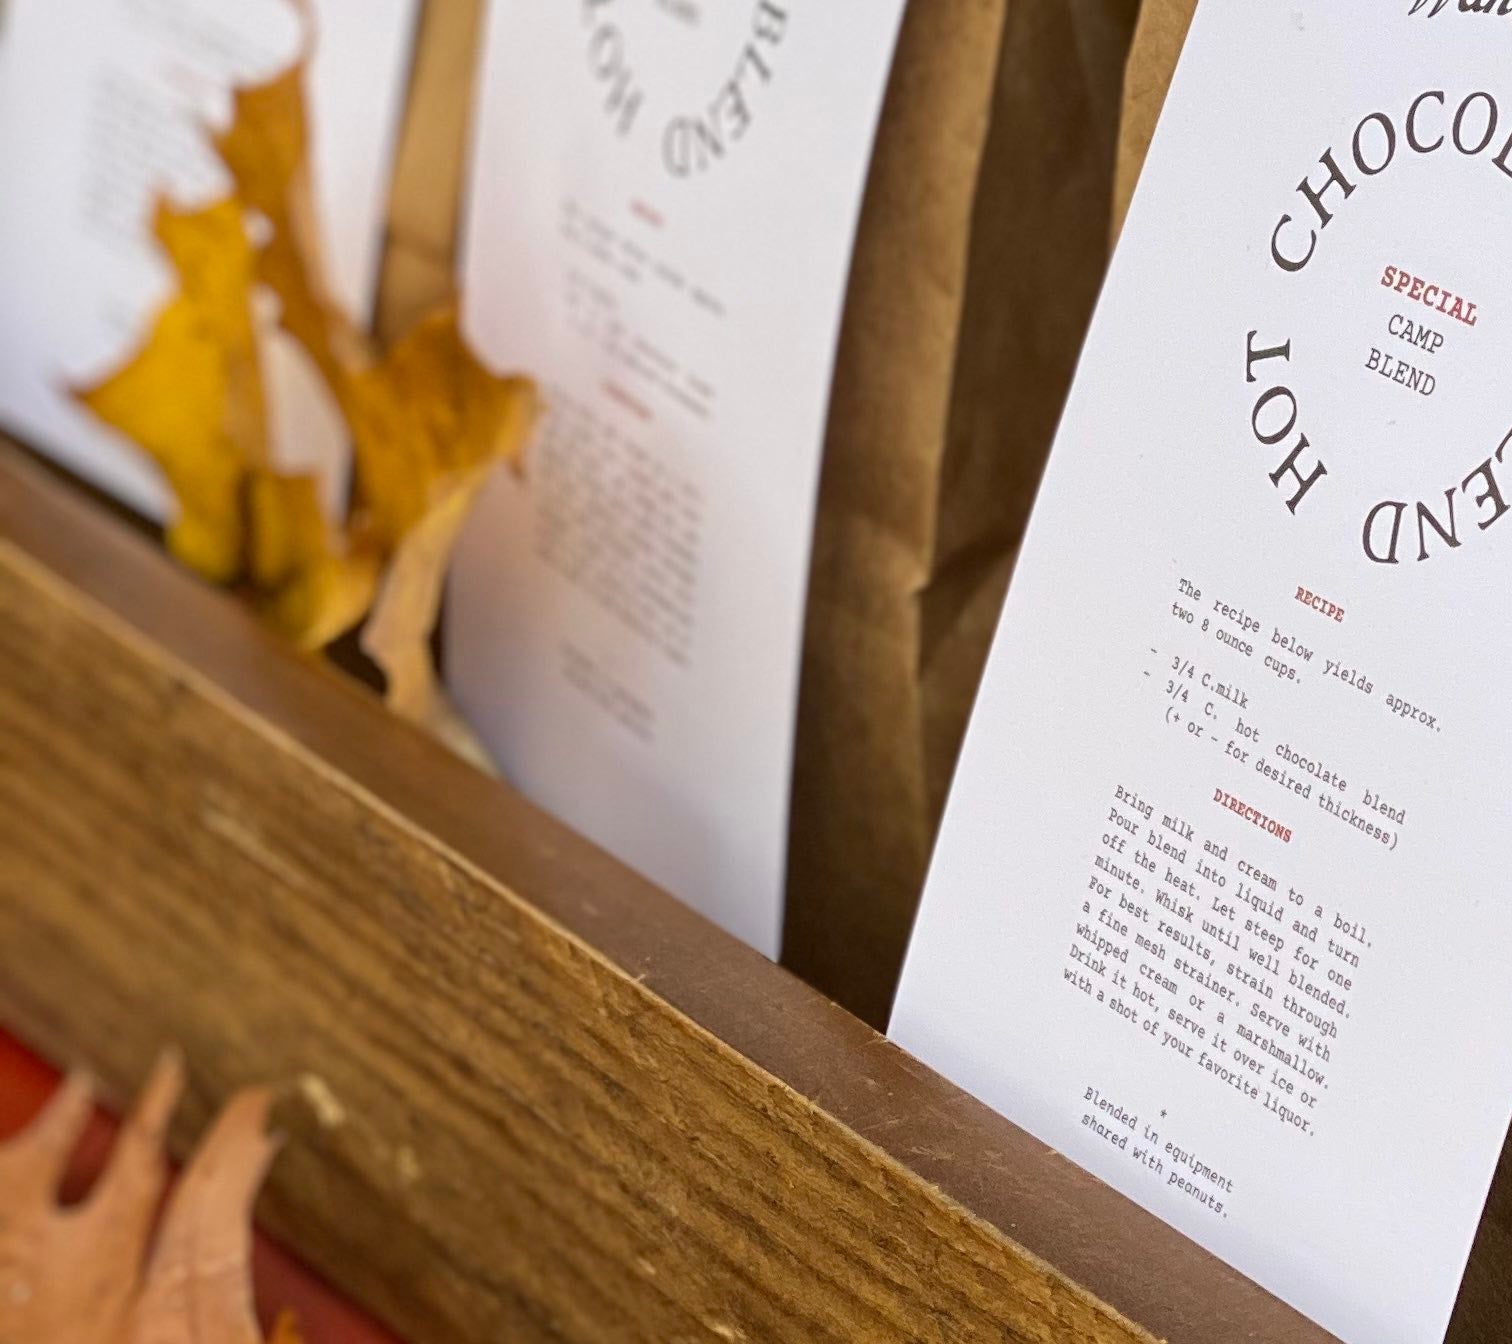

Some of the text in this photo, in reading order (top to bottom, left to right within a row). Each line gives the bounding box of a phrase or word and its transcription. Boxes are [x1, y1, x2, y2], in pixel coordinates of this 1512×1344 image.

[1365, 348, 1436, 396] BLEND
[1381, 265, 1477, 326] SPECIAL
[1388, 314, 1444, 354] CAMP
[1246, 330, 1327, 515] HOT
[1171, 601, 1194, 624] two
[1215, 628, 1253, 657] ounce
[1263, 655, 1300, 684] cups.
[1177, 577, 1440, 732] The recipe below yields approx.
[1294, 586, 1345, 623] RECIPE
[1186, 721, 1203, 737] or
[1223, 739, 1249, 763] for
[1255, 757, 1312, 799] desired
[1318, 792, 1397, 851] thickness)
[1212, 787, 1292, 843] DIRECTIONS
[1234, 716, 1260, 743] hot
[1275, 743, 1347, 791] chocolate
[1361, 788, 1406, 825] blend
[1093, 854, 1349, 1018] minute. Whisk until well blended.
[1101, 833, 1352, 991] off the heat. Let steep for one
[1106, 806, 1359, 968] Pour blend into liquid and turn
[1113, 784, 1371, 948] Bring milk and cream to a boil.
[1068, 943, 1317, 1108] Drink it hot, serve it over ice or
[1075, 922, 1328, 1089] whipped cream or a marshmallow.
[1081, 900, 1330, 1062] a fine mesh strainer. Serve with
[1087, 874, 1337, 1039] For best results, strain through
[1063, 967, 1314, 1136] with a shot of your favorite liquor.
[1080, 1113, 1227, 1218] shared with peanuts.
[1082, 1085, 1233, 1193] Blended in equipment
